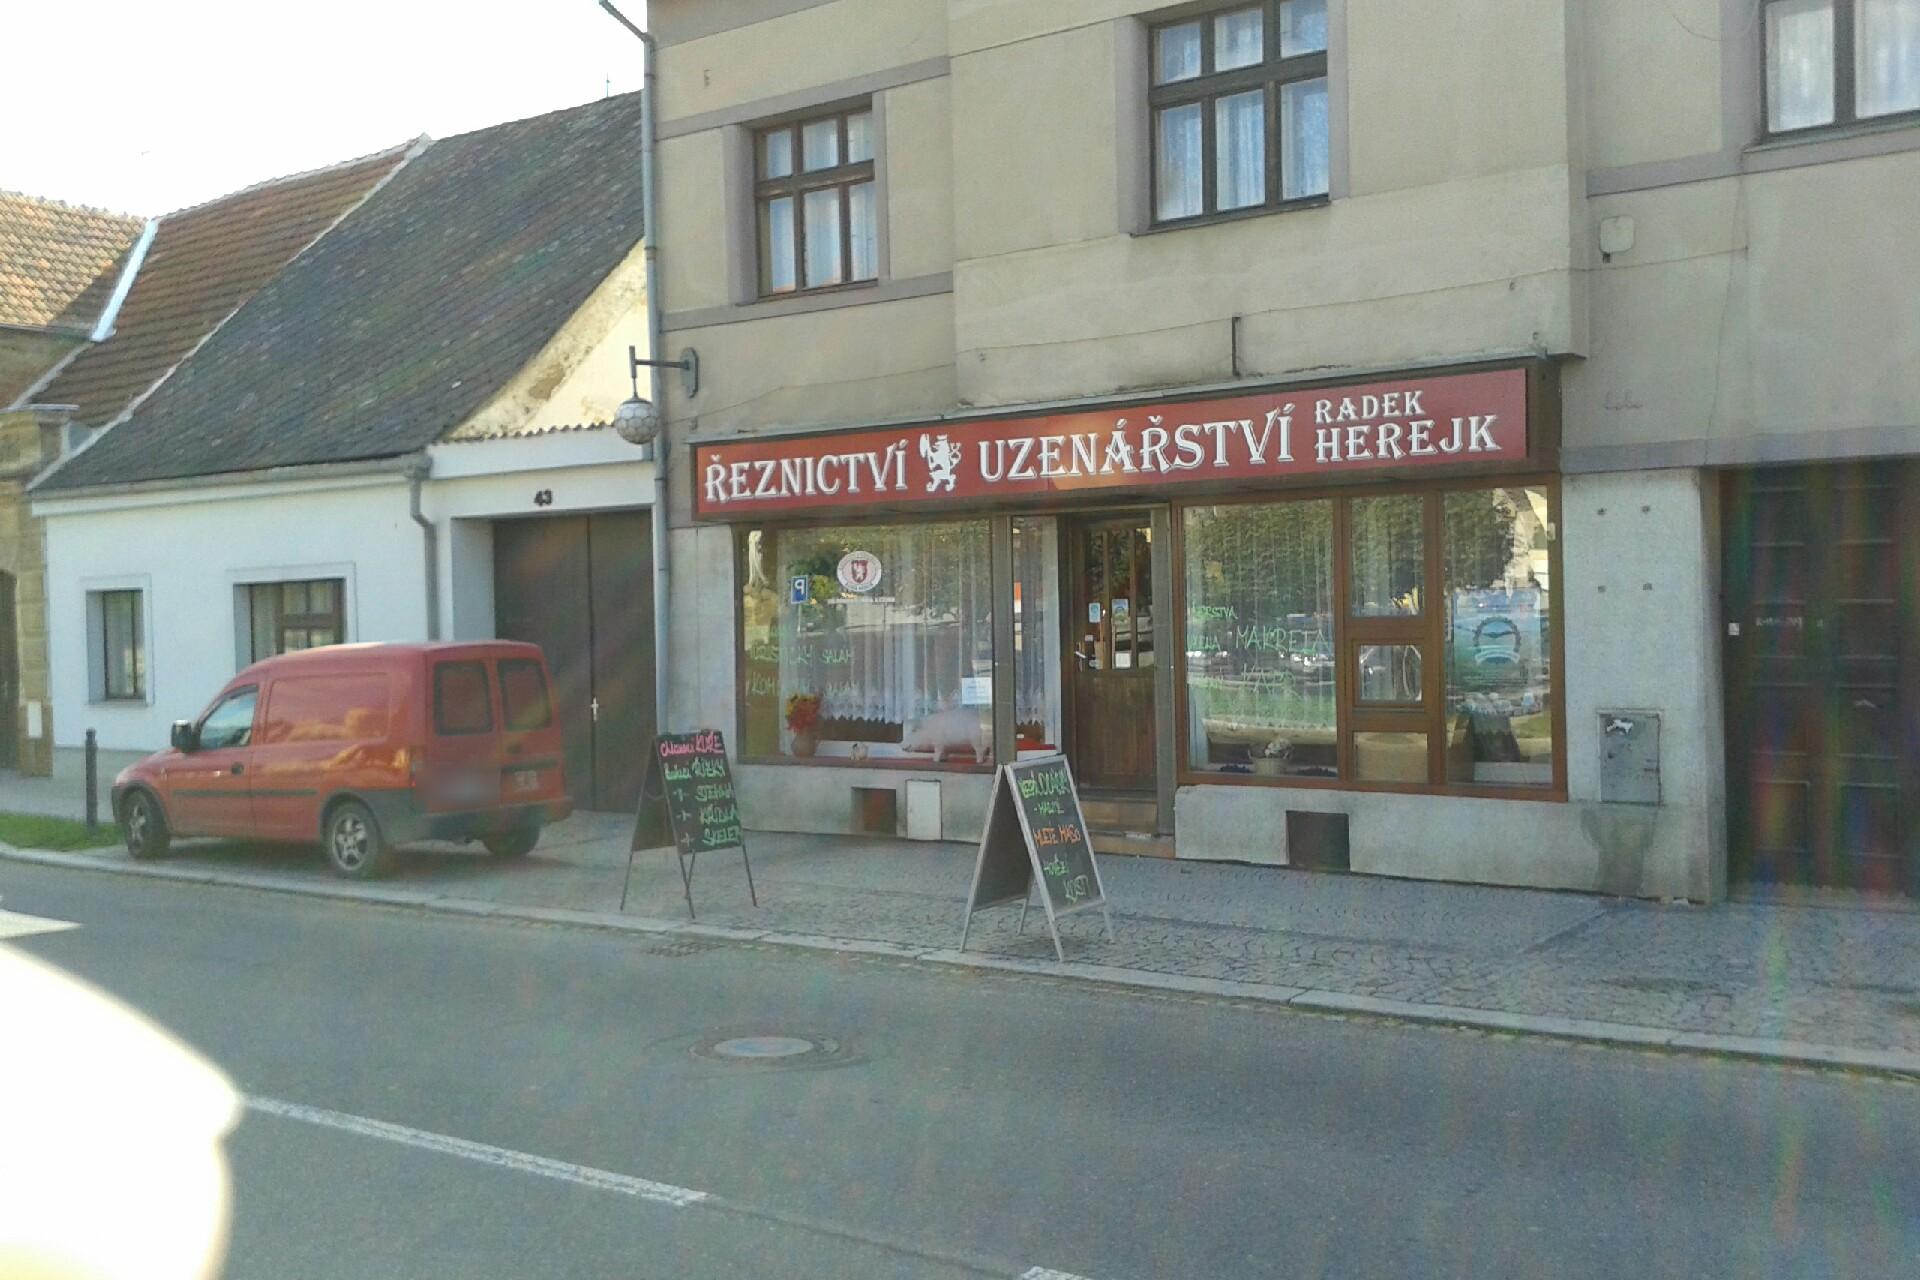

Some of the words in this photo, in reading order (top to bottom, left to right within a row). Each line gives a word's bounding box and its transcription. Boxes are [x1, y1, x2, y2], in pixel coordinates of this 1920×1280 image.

[1315, 390, 1426, 424] RADEK
[704, 439, 908, 503] ŘEZNICTVÍ
[977, 403, 1296, 482] UZENÁŘSTVÍ
[1314, 415, 1502, 463] HEREJK
